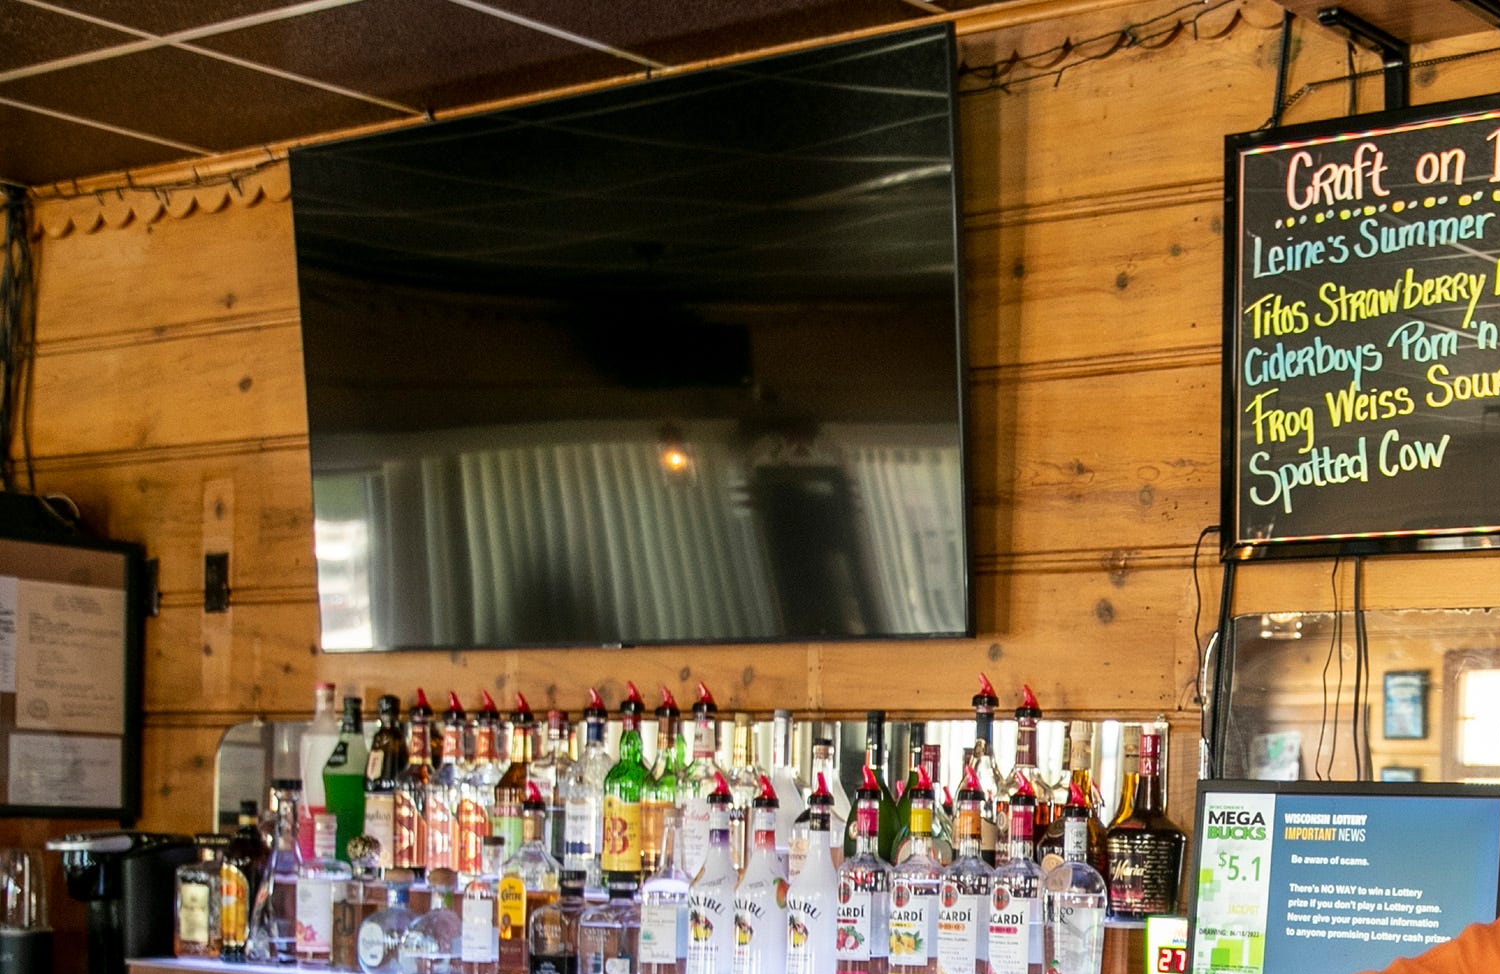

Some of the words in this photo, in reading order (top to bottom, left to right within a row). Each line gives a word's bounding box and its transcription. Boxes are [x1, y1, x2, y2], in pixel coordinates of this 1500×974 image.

[1286, 143, 1390, 211] Craft
[1416, 148, 1466, 186] on
[1252, 230, 1349, 279] Leine's
[1354, 213, 1496, 259] Summer
[1245, 294, 1307, 339] Titos
[1314, 269, 1486, 329] Strawberry
[1244, 340, 1382, 390] Ciderboys
[1387, 321, 1458, 362] Pom
[1245, 390, 1315, 453] Frog
[1326, 382, 1415, 429] Weiss
[1249, 439, 1368, 513] Spotted
[1378, 429, 1451, 478] Cow
[1208, 811, 1266, 825] MEGA
[1285, 813, 1330, 825] WISCONSIN
[1332, 814, 1368, 825] LOTTERY
[1207, 826, 1266, 840] BUCKS
[1284, 827, 1337, 840] IMPORTANT
[1338, 828, 1366, 842] NEWS
[1218, 851, 1261, 881] $5.1
[1291, 855, 1302, 863] Be
[1330, 856, 1339, 864] of
[1340, 858, 1370, 866] scams.
[1289, 883, 1319, 892] There's
[1321, 885, 1334, 893] NO
[1336, 885, 1357, 894] WAY
[1358, 887, 1367, 895] to
[1368, 887, 1383, 896] win
[1392, 888, 1422, 899] Lottery
[689, 896, 726, 915] ALIBU
[837, 905, 864, 917] CARDÍ
[1288, 898, 1308, 908] prize
[1310, 899, 1316, 907] if
[1317, 901, 1333, 910] you
[1334, 900, 1356, 909] don't
[1357, 902, 1375, 912] play
[1384, 902, 1414, 913] Lottery
[1416, 905, 1442, 914] game.
[1287, 912, 1311, 922] Never
[1312, 914, 1330, 924] give
[1335, 916, 1351, 925] your
[1352, 917, 1389, 926] personal
[1390, 918, 1439, 928] information
[1286, 928, 1295, 936] to
[1296, 930, 1326, 938] anyone
[1328, 931, 1369, 941] promising
[1371, 931, 1401, 943] Lottery
[1402, 934, 1423, 942] cash
